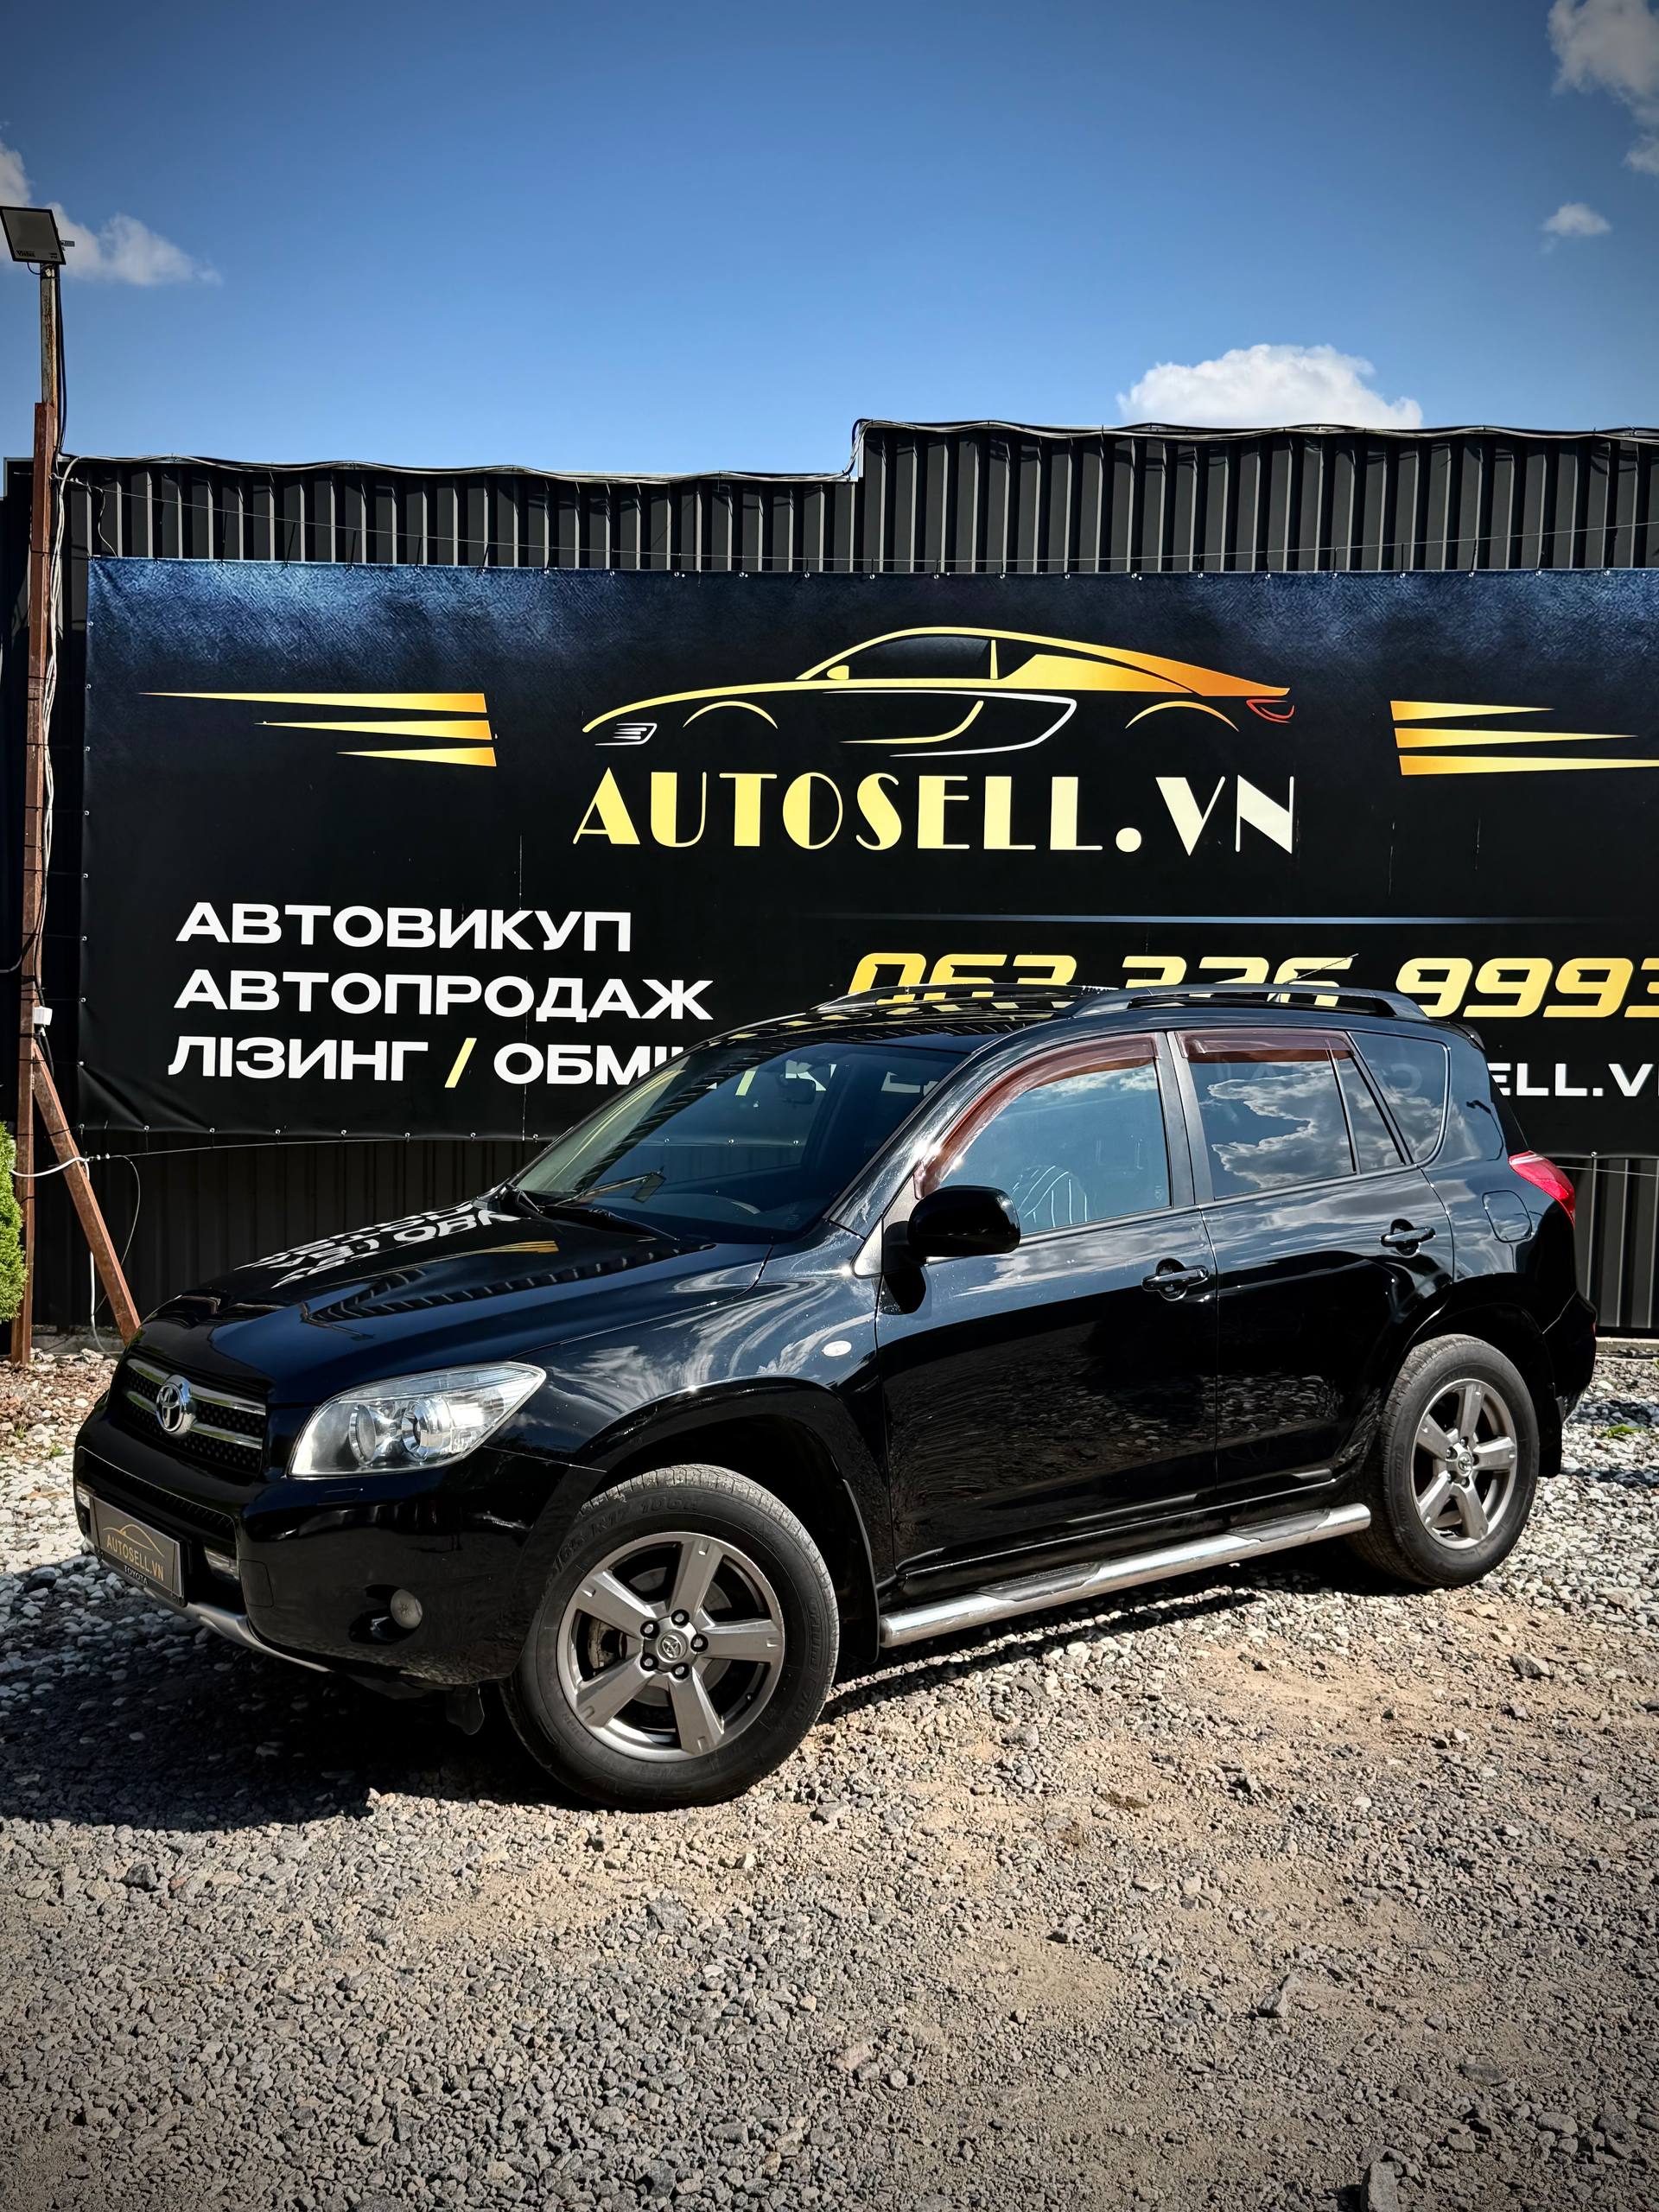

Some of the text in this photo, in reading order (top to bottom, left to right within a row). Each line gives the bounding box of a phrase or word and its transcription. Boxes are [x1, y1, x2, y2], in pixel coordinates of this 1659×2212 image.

[572, 766, 1295, 856] AUTOSELL.VN
[175, 901, 632, 952] АВТОВИКУП
[173, 969, 714, 1023] АВТОПРОДАЖ
[1395, 957, 1659, 1018] 999
[168, 1035, 429, 1082] ЛІЗИНГ
[493, 1042, 684, 1086] ОБМ
[106, 1535, 164, 1581] AUTOSELL.VN
[124, 1565, 148, 1586] TOYOTA
